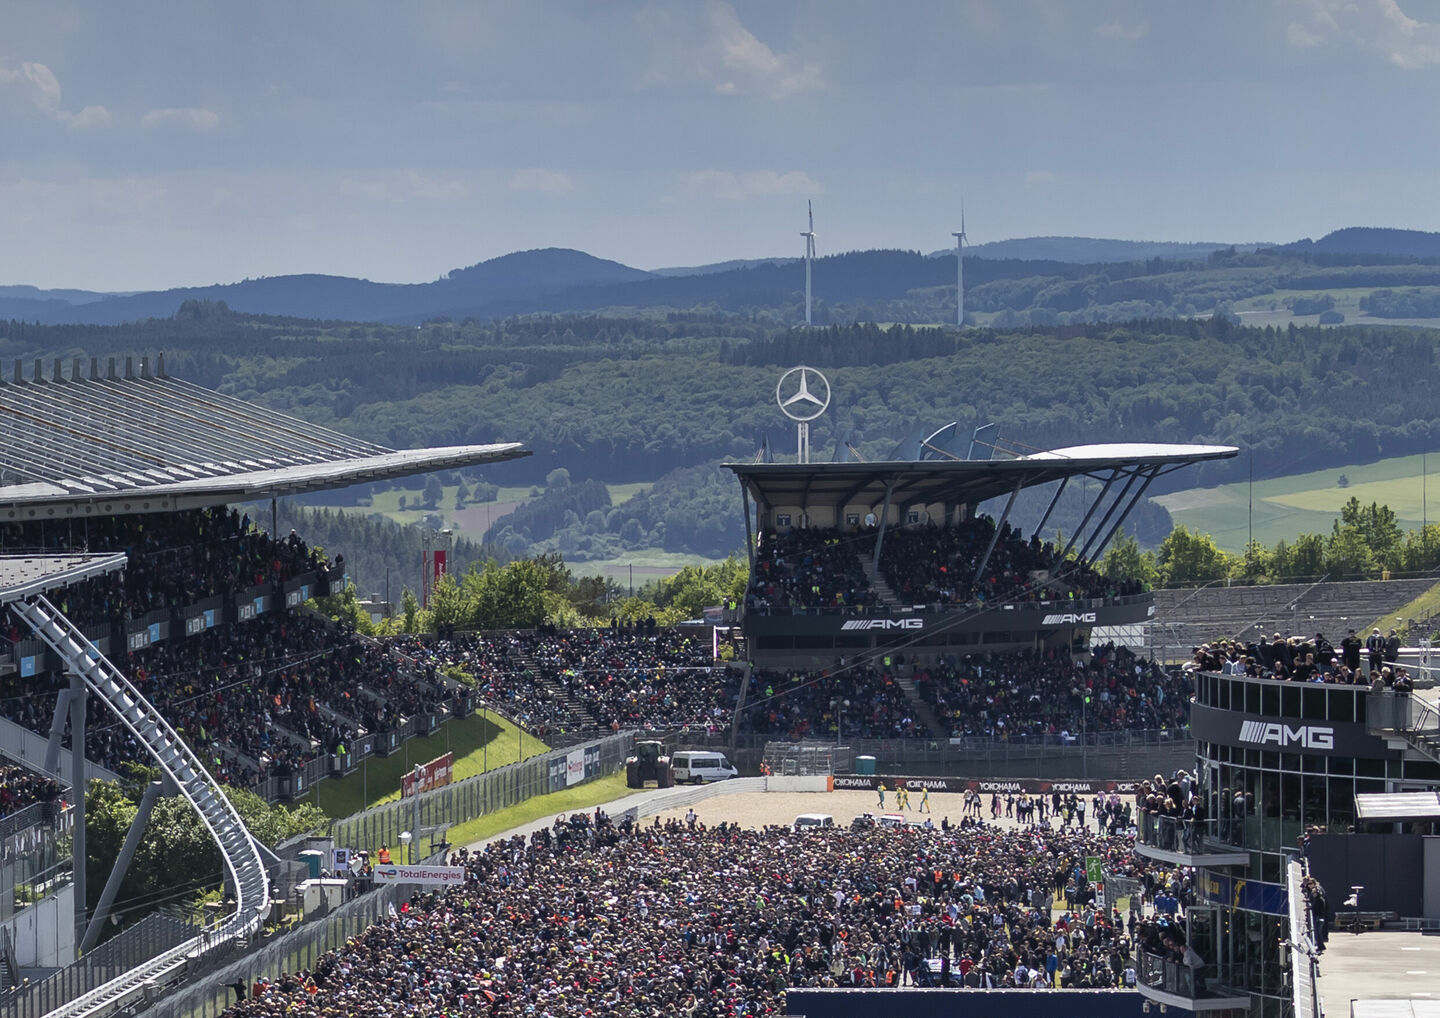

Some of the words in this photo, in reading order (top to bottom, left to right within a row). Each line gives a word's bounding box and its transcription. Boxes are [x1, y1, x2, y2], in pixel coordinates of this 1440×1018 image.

[870, 618, 923, 629] AMG
[1060, 612, 1097, 624] AMG
[1261, 722, 1334, 750] AMG
[905, 780, 947, 789] YOKOHAMA
[979, 782, 1021, 791] YOKOHAMA
[1051, 783, 1091, 792] YOKOHAMA
[398, 869, 461, 881] TotalEnergies
